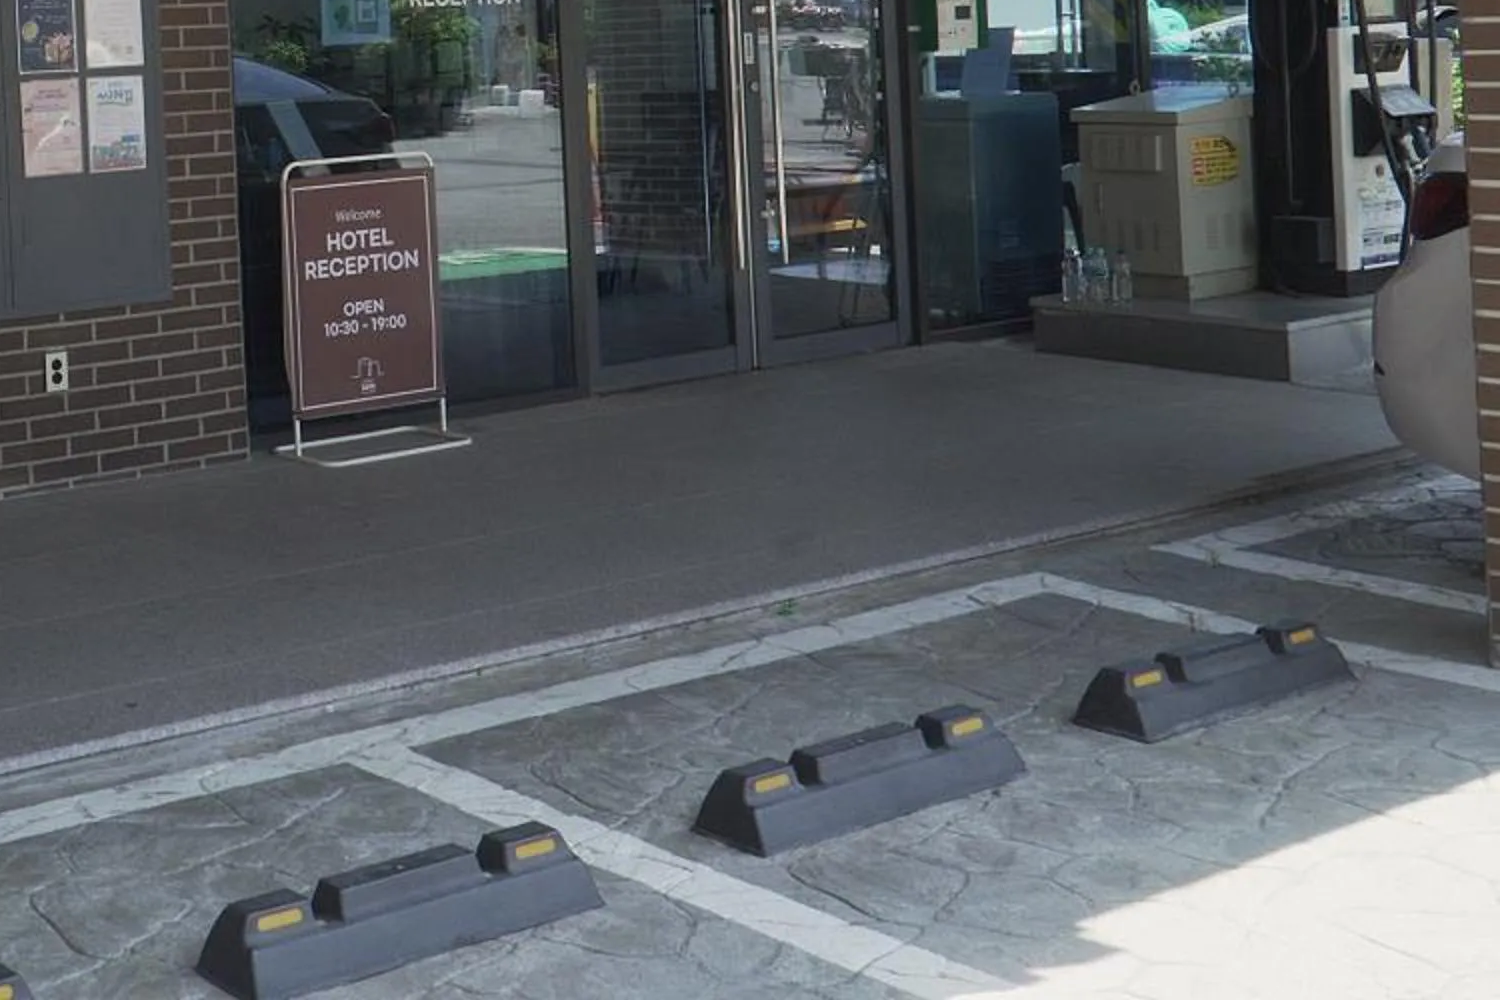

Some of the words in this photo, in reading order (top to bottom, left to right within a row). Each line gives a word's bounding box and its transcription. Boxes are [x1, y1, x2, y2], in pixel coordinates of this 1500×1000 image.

[335, 208, 382, 223] Welcome
[326, 227, 395, 252] HOTEL
[304, 249, 419, 280] RECEPTION
[343, 298, 385, 316] OPEN
[324, 319, 359, 337] 10:30
[371, 314, 407, 331] 19:00
